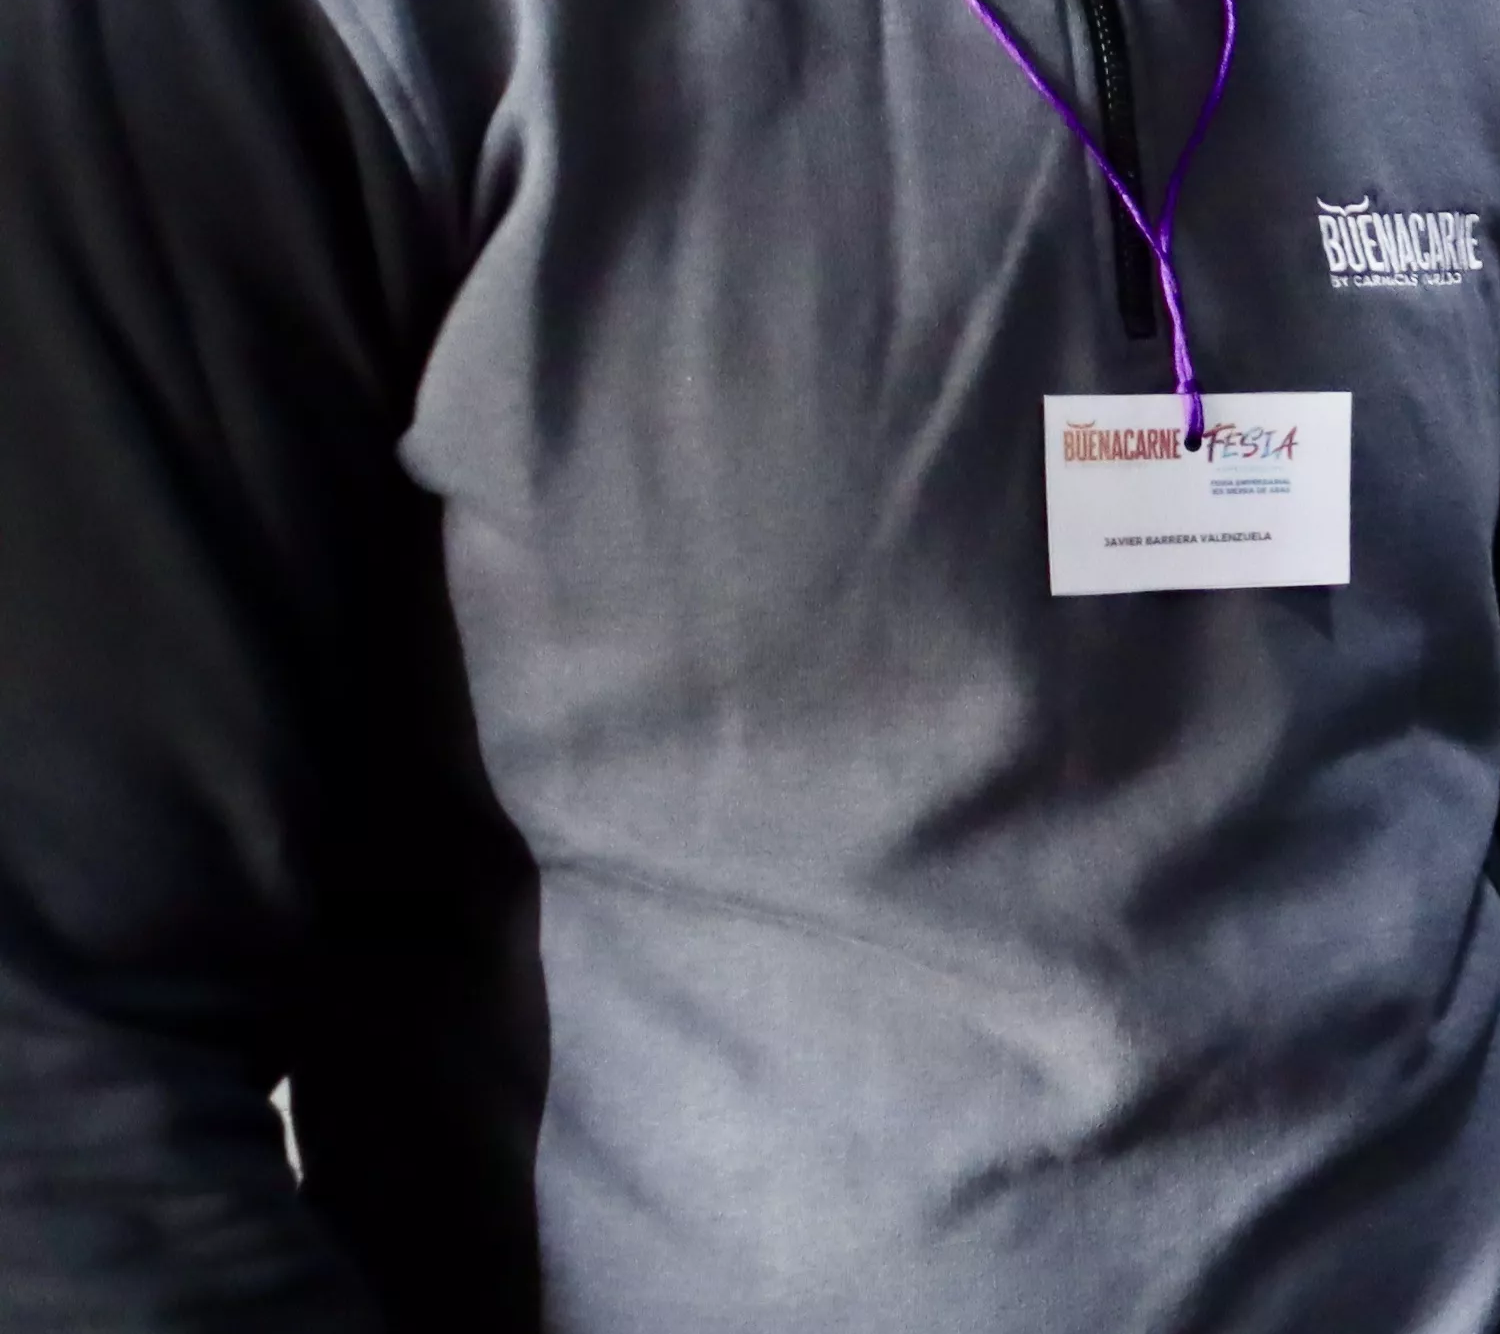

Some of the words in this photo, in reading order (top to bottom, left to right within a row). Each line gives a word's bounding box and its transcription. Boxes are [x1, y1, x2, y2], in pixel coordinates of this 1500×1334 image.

[1318, 211, 1483, 273] BUENACARNE
[1063, 425, 1182, 462] BUENACARNE
[1104, 535, 1143, 548] JAVIER
[1146, 533, 1197, 546] BARRERA
[1200, 531, 1272, 544] VALENZUELA
